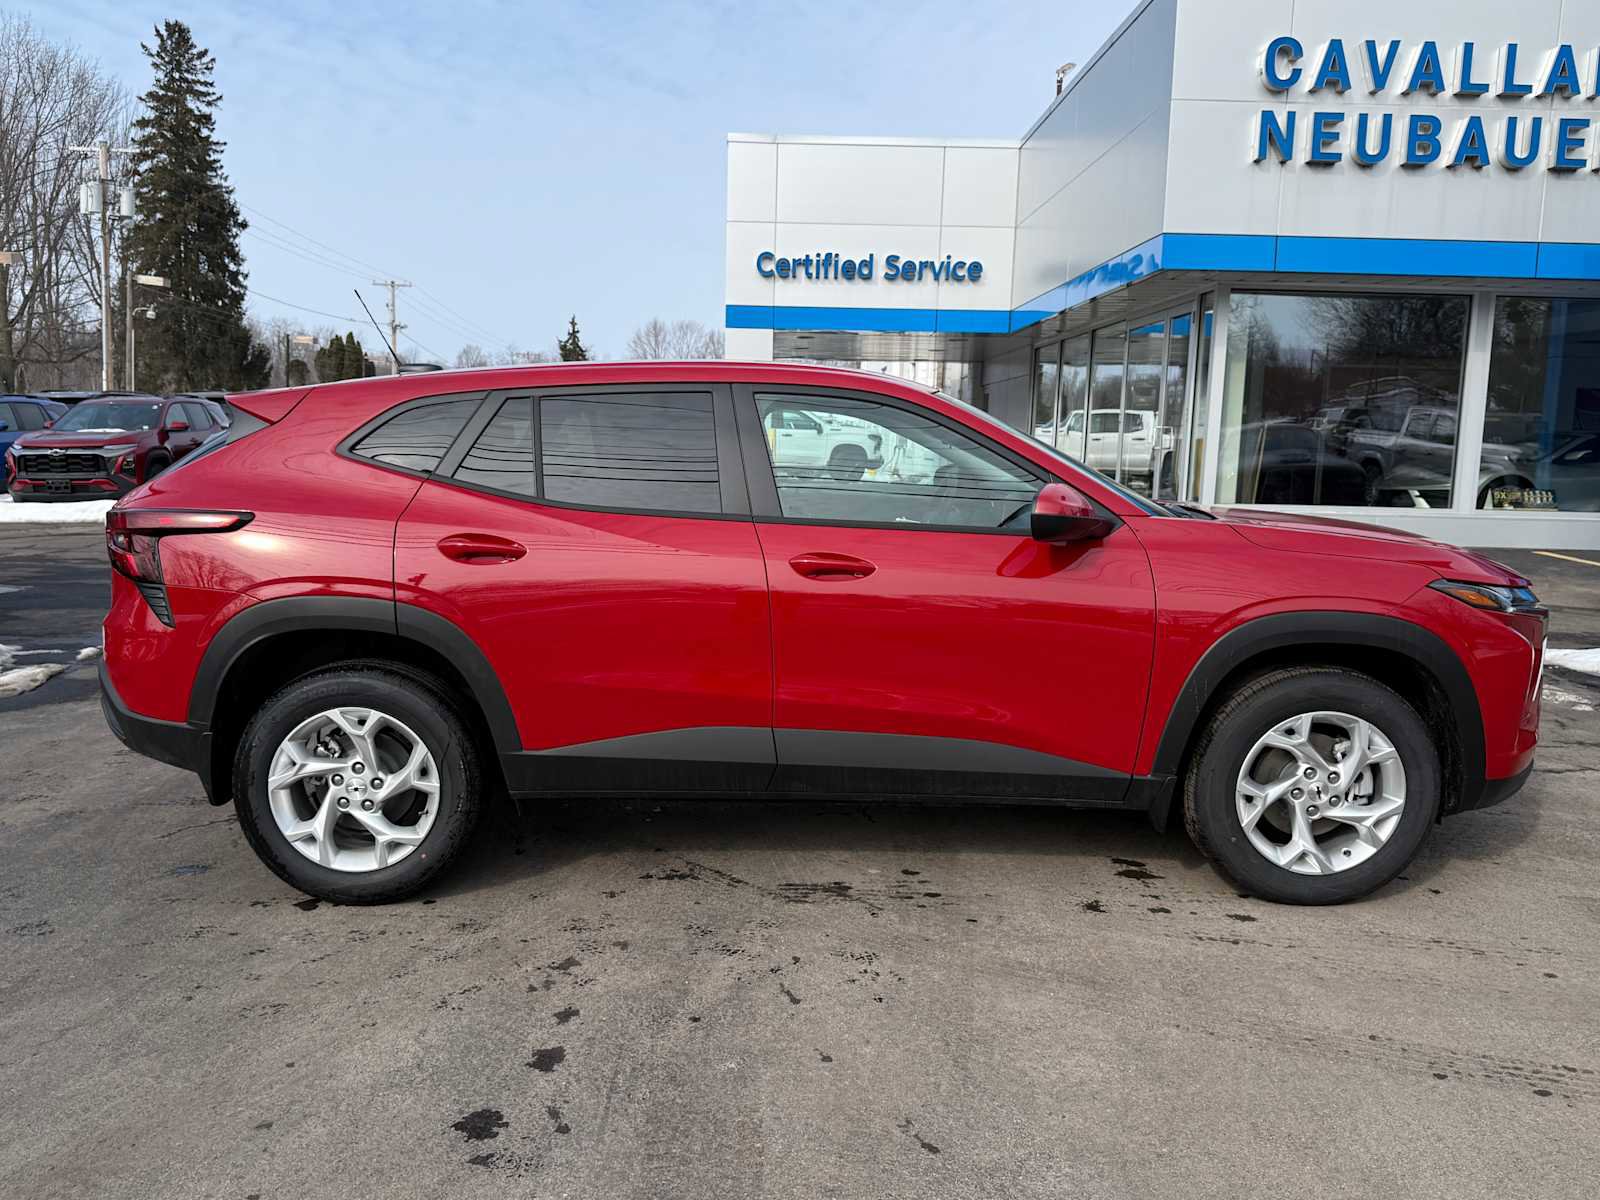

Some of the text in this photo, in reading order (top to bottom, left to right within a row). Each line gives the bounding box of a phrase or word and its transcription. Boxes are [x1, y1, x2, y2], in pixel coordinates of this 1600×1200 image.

[1264, 36, 1600, 97] CAVALLA
[1256, 110, 1600, 169] NEUBAUE
[756, 251, 983, 282] Certified Service
